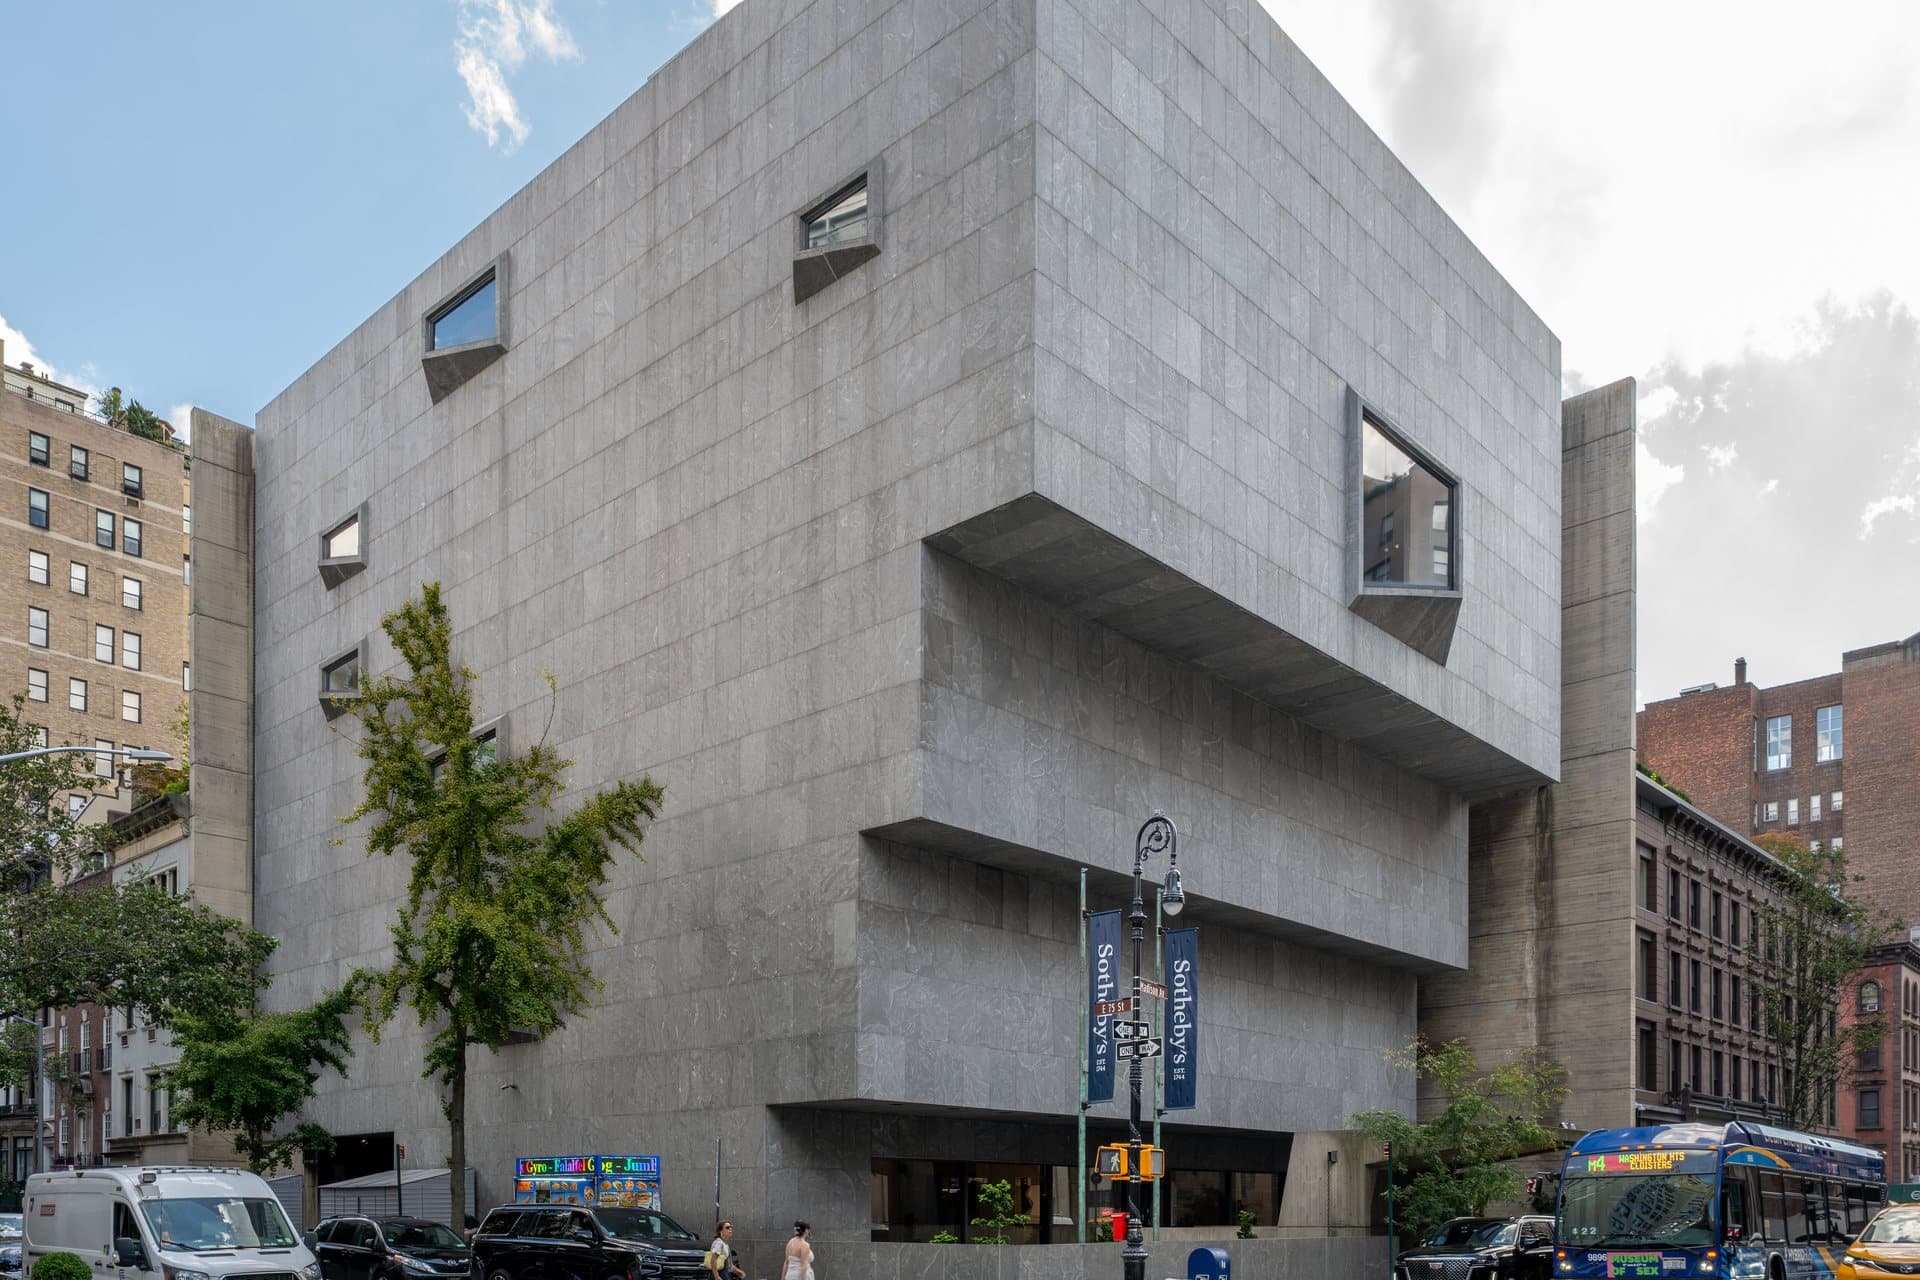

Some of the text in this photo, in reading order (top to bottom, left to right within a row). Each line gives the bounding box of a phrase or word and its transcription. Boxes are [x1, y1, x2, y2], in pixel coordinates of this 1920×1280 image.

[1140, 982, 1158, 997] Madison
[1093, 944, 1114, 1055] Sothby's
[1102, 1001, 1125, 1014] E 75 St
[1169, 959, 1193, 1064] Sotheby's
[1119, 1026, 1130, 1034] ONE
[1121, 1043, 1154, 1055] ONE WAY
[1588, 1154, 1606, 1172] M4
[1618, 1151, 1685, 1164] WASHINGTON HTS
[525, 1160, 547, 1176] Gyro
[1630, 1160, 1672, 1170] CLOISTERS
[1587, 1253, 1607, 1262] 9896
[1611, 1254, 1659, 1263] MUSEUM
[1613, 1267, 1659, 1276] OF SEX
